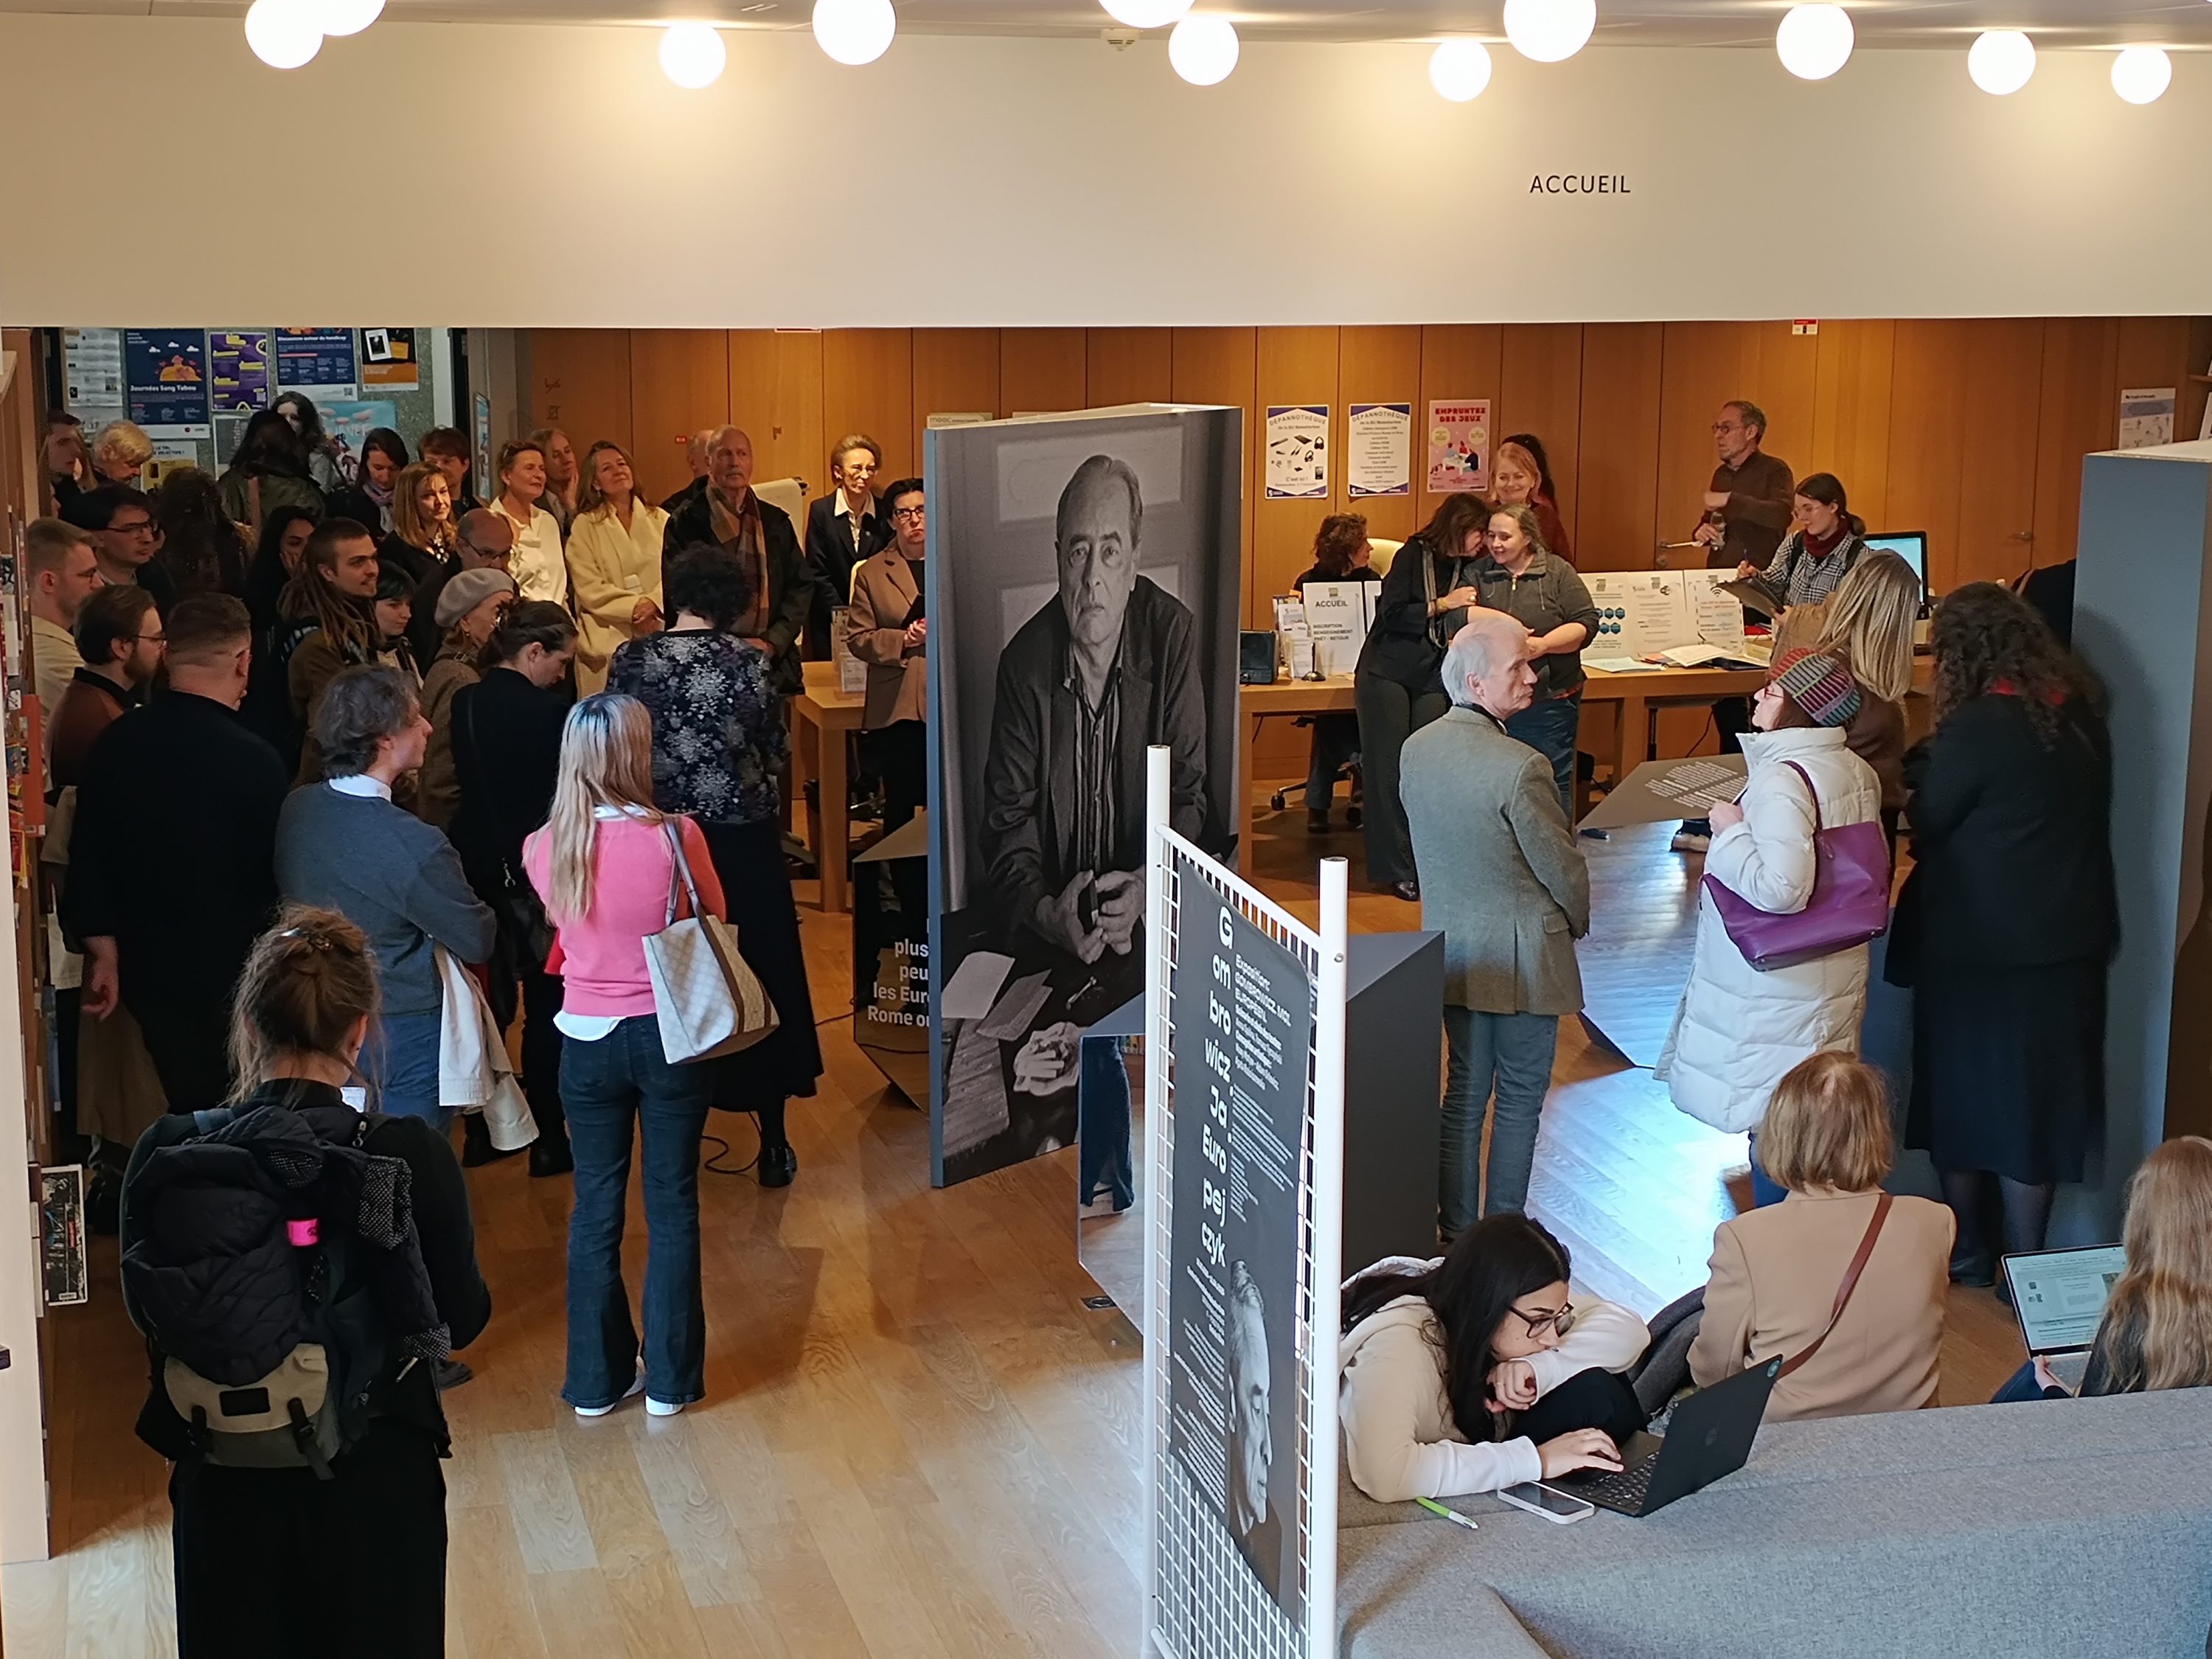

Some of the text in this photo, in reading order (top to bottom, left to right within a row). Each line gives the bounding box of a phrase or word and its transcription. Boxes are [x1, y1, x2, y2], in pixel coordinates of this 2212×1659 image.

[1530, 175, 1631, 193] ACCUEIL
[1435, 407, 1486, 415] EMPRUNTEZ
[1458, 414, 1482, 422] JEUX
[1315, 599, 1349, 608] ACCUEIL
[1219, 905, 1234, 950] G
[894, 938, 929, 958] plus
[1212, 953, 1231, 990] om
[873, 981, 897, 1000] les
[866, 1005, 914, 1025] Rome
[1208, 990, 1232, 1035] bro
[1203, 1123, 1227, 1174] Euro
[1203, 1177, 1226, 1228] pej
[1202, 1221, 1226, 1267] czyk
